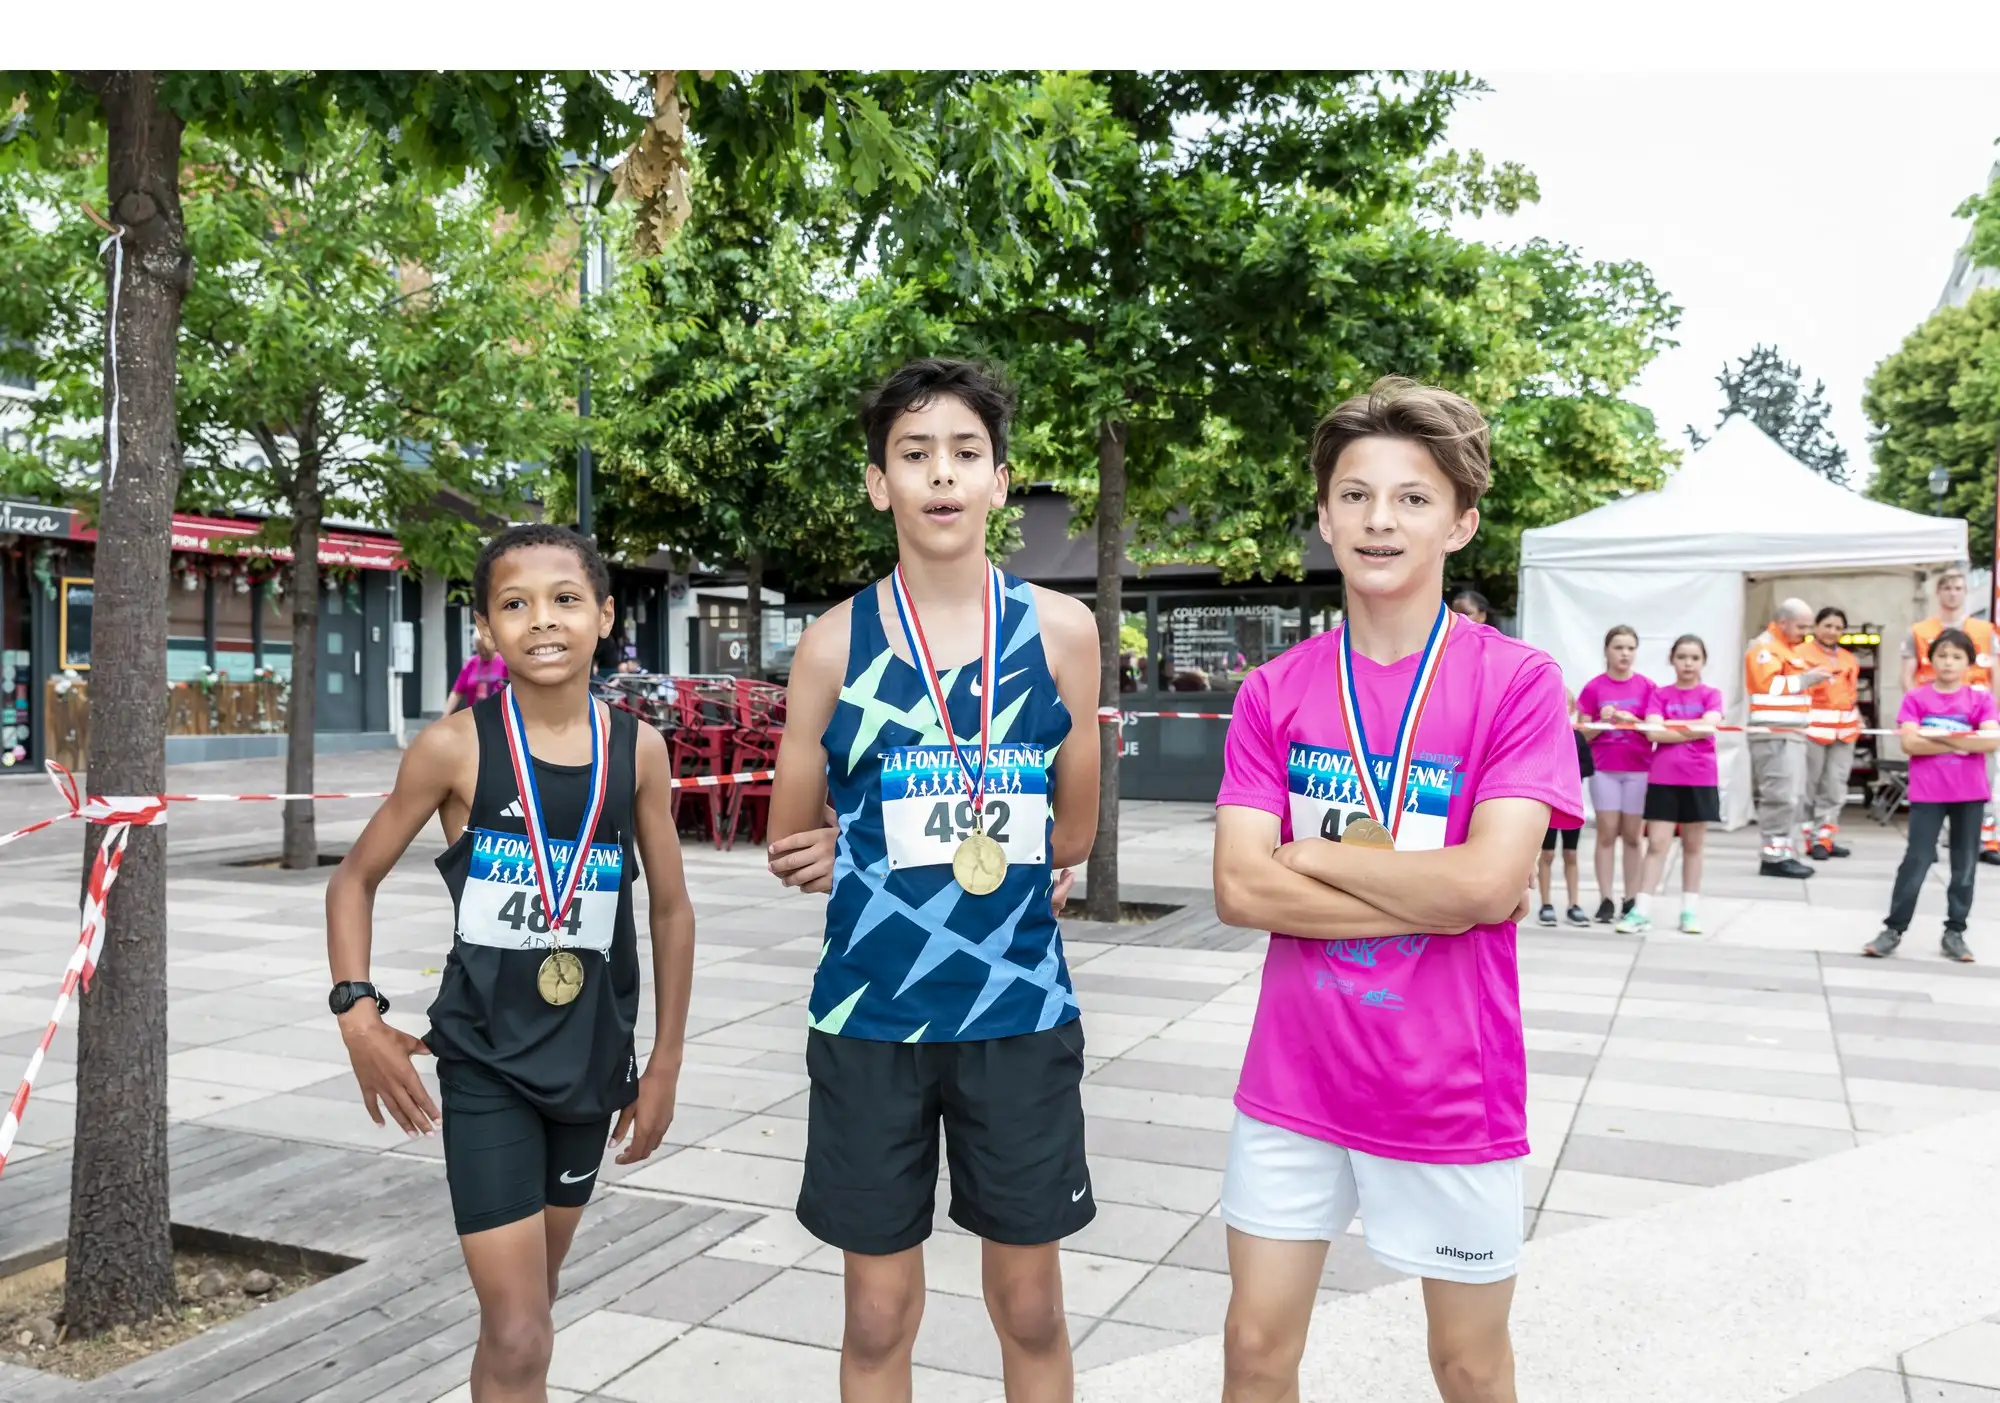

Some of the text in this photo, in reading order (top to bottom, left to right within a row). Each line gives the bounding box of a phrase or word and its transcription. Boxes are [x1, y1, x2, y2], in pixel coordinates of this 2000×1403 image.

[1173, 606, 1233, 620] COUSCOUS
[883, 752, 902, 773] LA
[1290, 749, 1306, 767] LA
[924, 799, 1011, 844] 492
[475, 835, 492, 854] LA
[497, 890, 583, 937] 484
[1436, 1245, 1494, 1262] uhlsport
